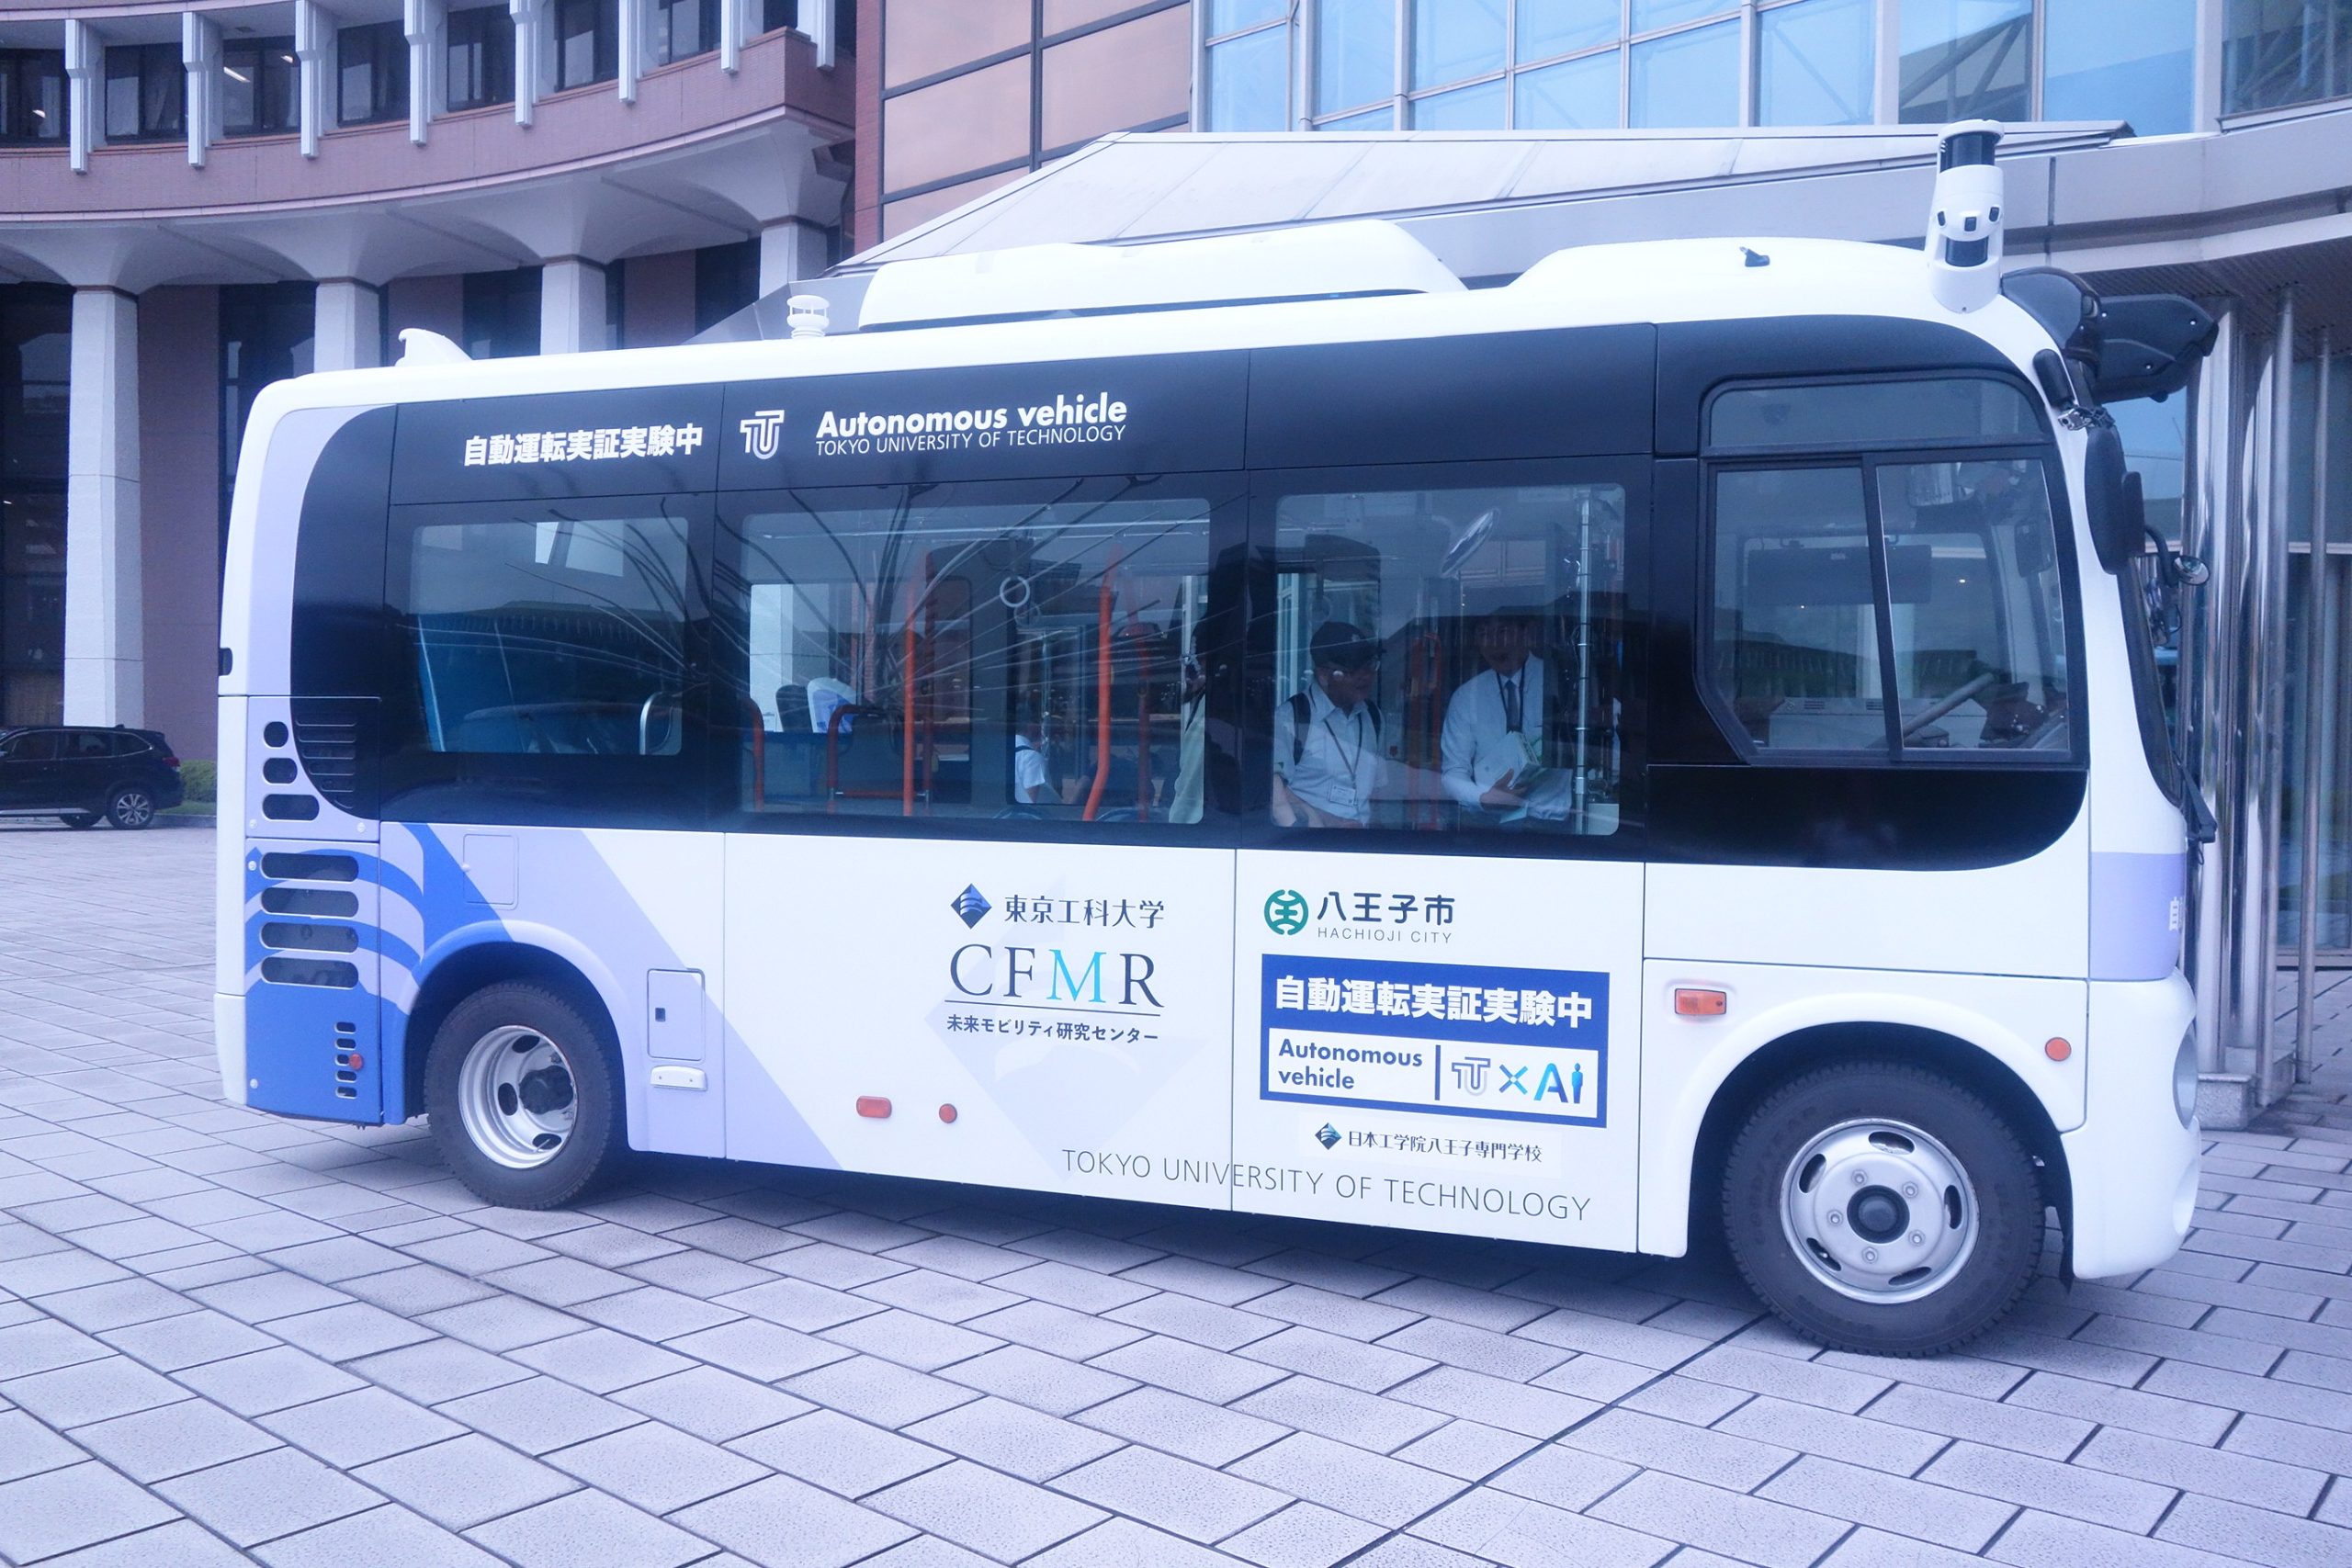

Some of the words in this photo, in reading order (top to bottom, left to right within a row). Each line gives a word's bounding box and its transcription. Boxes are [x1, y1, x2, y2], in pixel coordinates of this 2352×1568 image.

[815, 406, 1008, 438] Autonomous
[1017, 391, 1127, 427] vehicle
[464, 423, 703, 467] 自動運転実証実験中
[815, 438, 870, 457] TOKYO
[876, 433, 974, 454] UNIVERSITY
[978, 431, 1001, 448] OF
[1007, 424, 1127, 446] TECHNOLOGY
[1003, 894, 1165, 930] 東京工科大学
[1316, 890, 1456, 926] 八王子市
[1317, 926, 1401, 942] HACHIOJI
[1410, 930, 1453, 944] CITY
[949, 942, 1166, 1009] CFMR
[1274, 975, 1593, 1029] 自動運転実証実験中
[946, 1013, 1159, 1044] 未来モビリティ研究センター
[1278, 1038, 1424, 1068] Autonomous
[1278, 1066, 1355, 1089] vehicle
[1348, 1130, 1544, 1163] 日本工学院八王子専門学校
[1060, 1148, 1151, 1179] TOKYO
[1162, 1156, 1324, 1195] UNIVERSITY
[1335, 1174, 1374, 1201] OF
[1383, 1178, 1592, 1223] TECHNOLOGY
